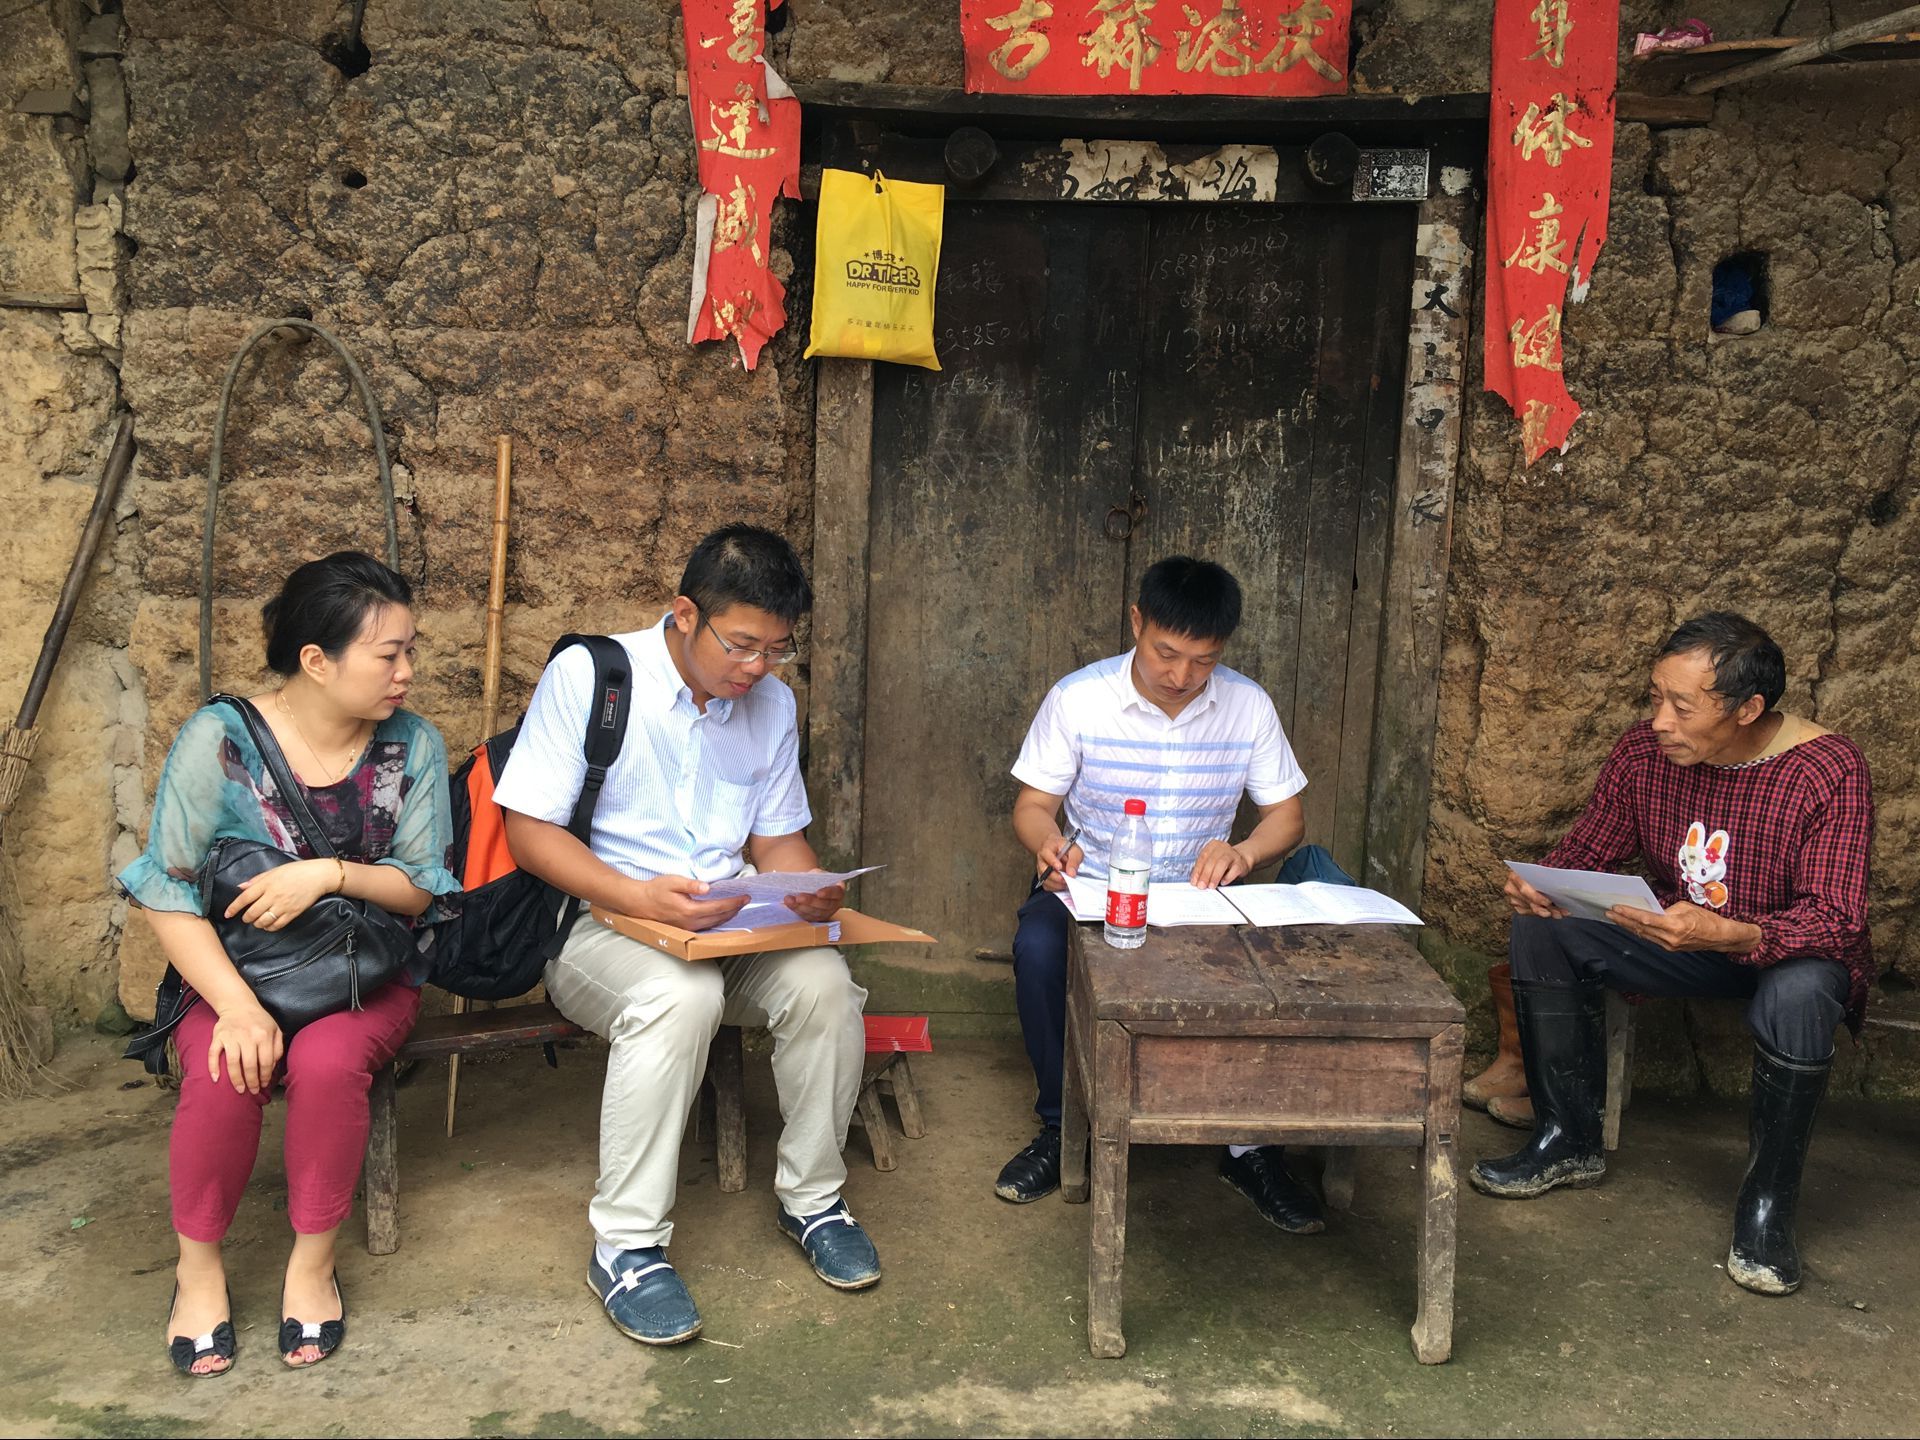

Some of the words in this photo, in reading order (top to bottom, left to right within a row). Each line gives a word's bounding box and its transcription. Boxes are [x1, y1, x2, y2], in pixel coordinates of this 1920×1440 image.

[846, 281, 870, 289] HAPPY
[872, 284, 887, 292] FOR
[908, 288, 920, 296] KID
